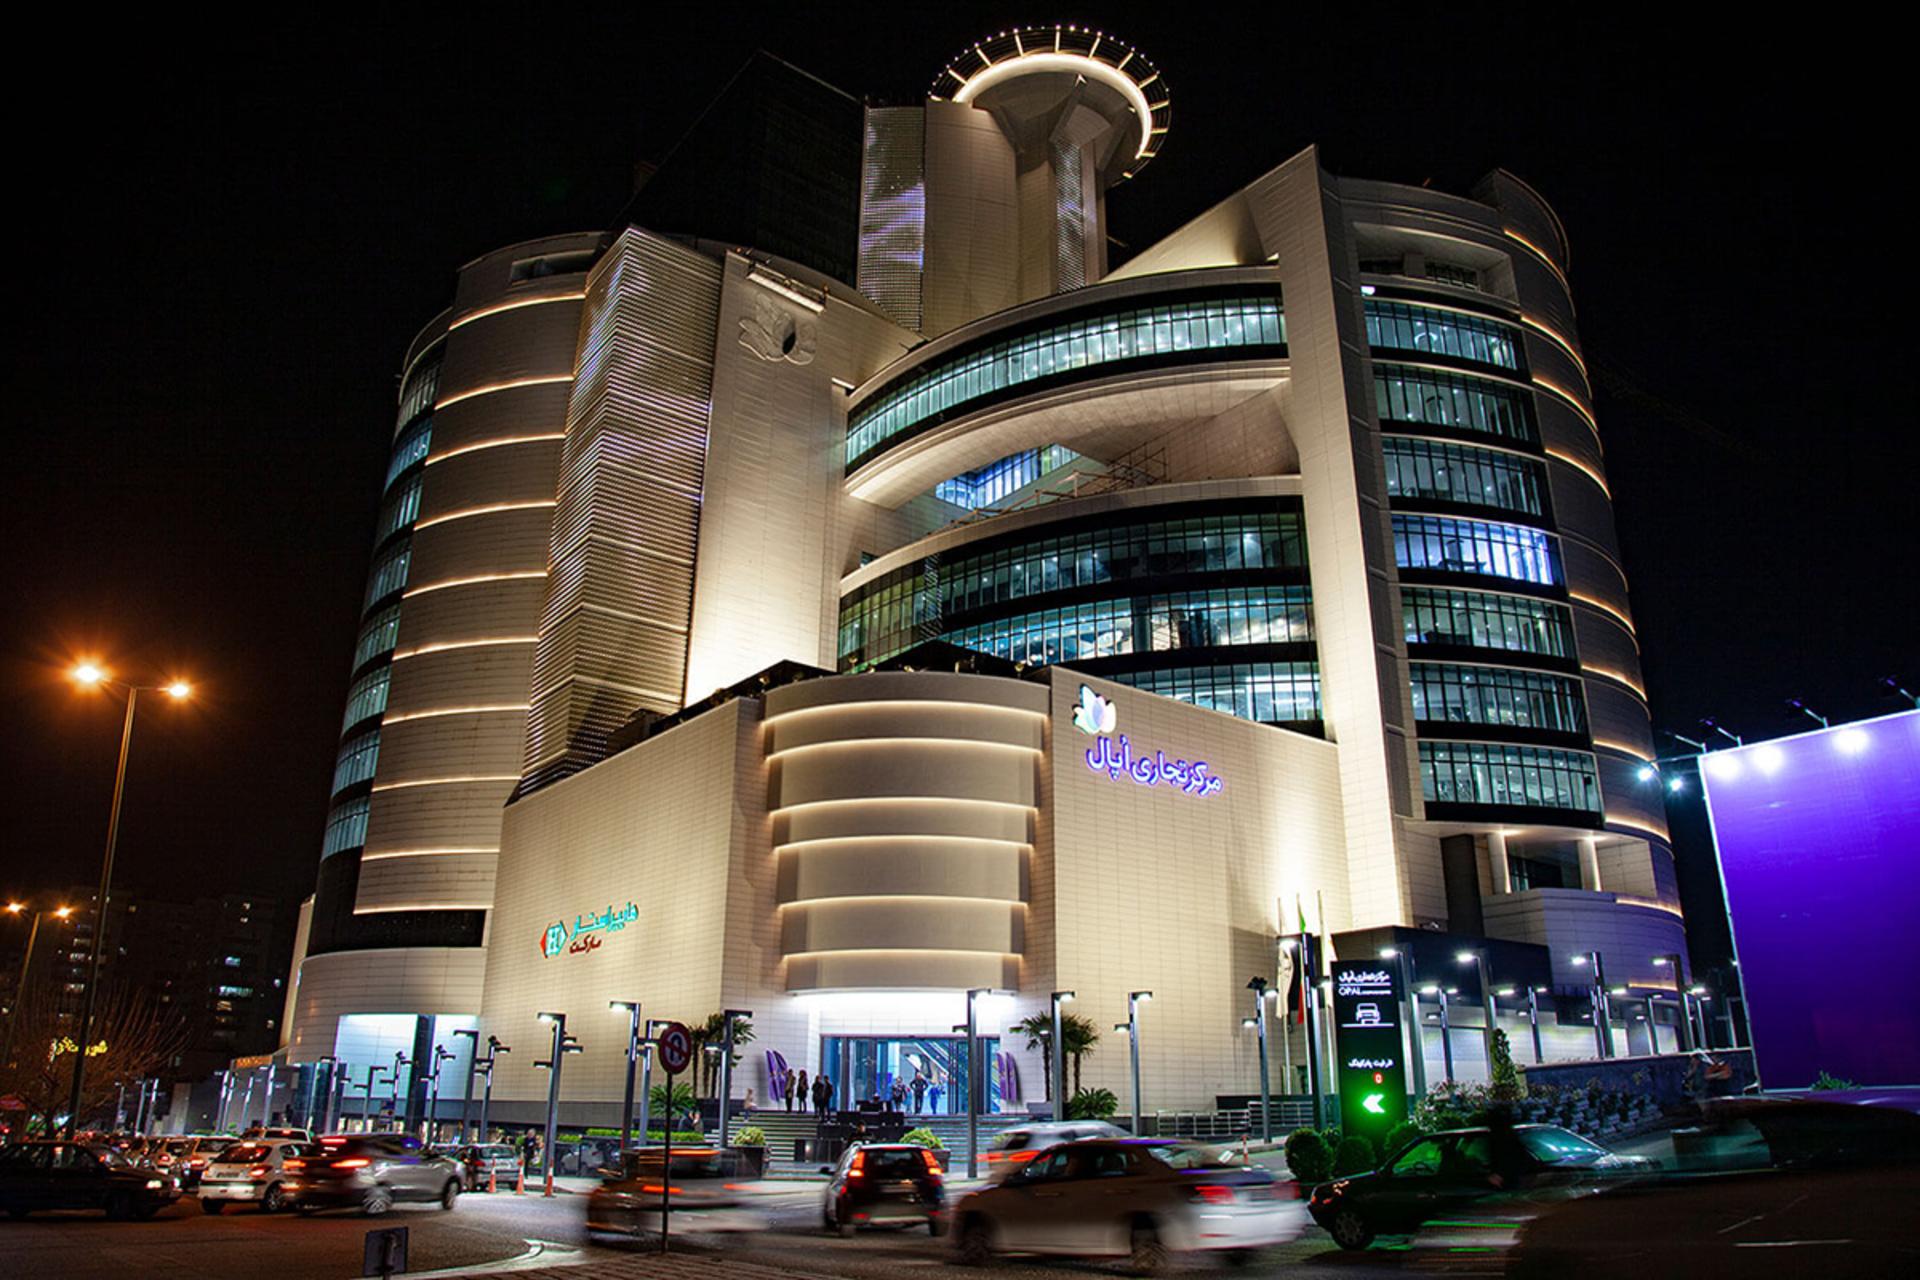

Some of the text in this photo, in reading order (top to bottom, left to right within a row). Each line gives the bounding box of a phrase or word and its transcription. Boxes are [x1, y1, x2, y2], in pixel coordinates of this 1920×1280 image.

[1132, 751, 1187, 785] تجاری
[1184, 761, 1223, 795] مرکز
[569, 934, 602, 954] مارکت
[1338, 986, 1361, 996] OPAL
